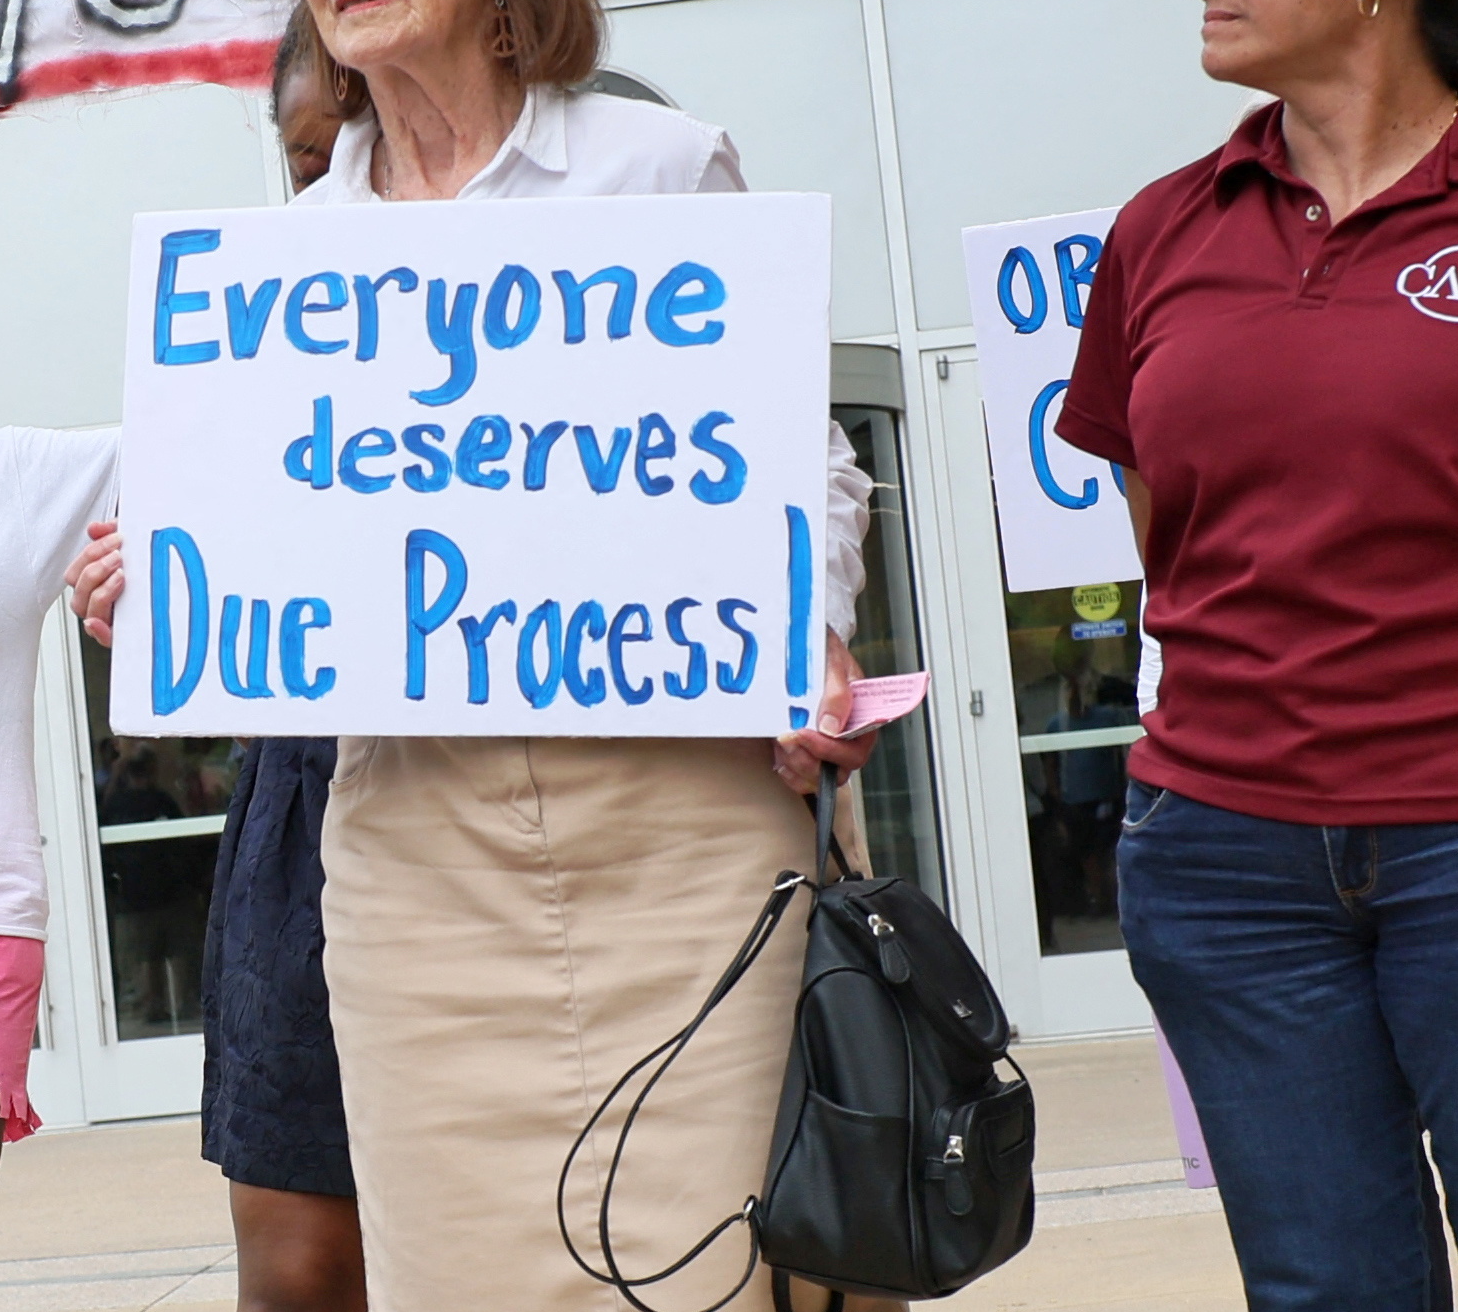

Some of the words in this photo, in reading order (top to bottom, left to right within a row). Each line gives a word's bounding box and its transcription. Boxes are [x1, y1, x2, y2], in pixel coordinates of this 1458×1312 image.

[154, 229, 728, 407] Everyone
[997, 234, 1103, 334] OB
[284, 395, 748, 505] deserves
[150, 527, 337, 716] Due
[403, 505, 814, 730] Process!
